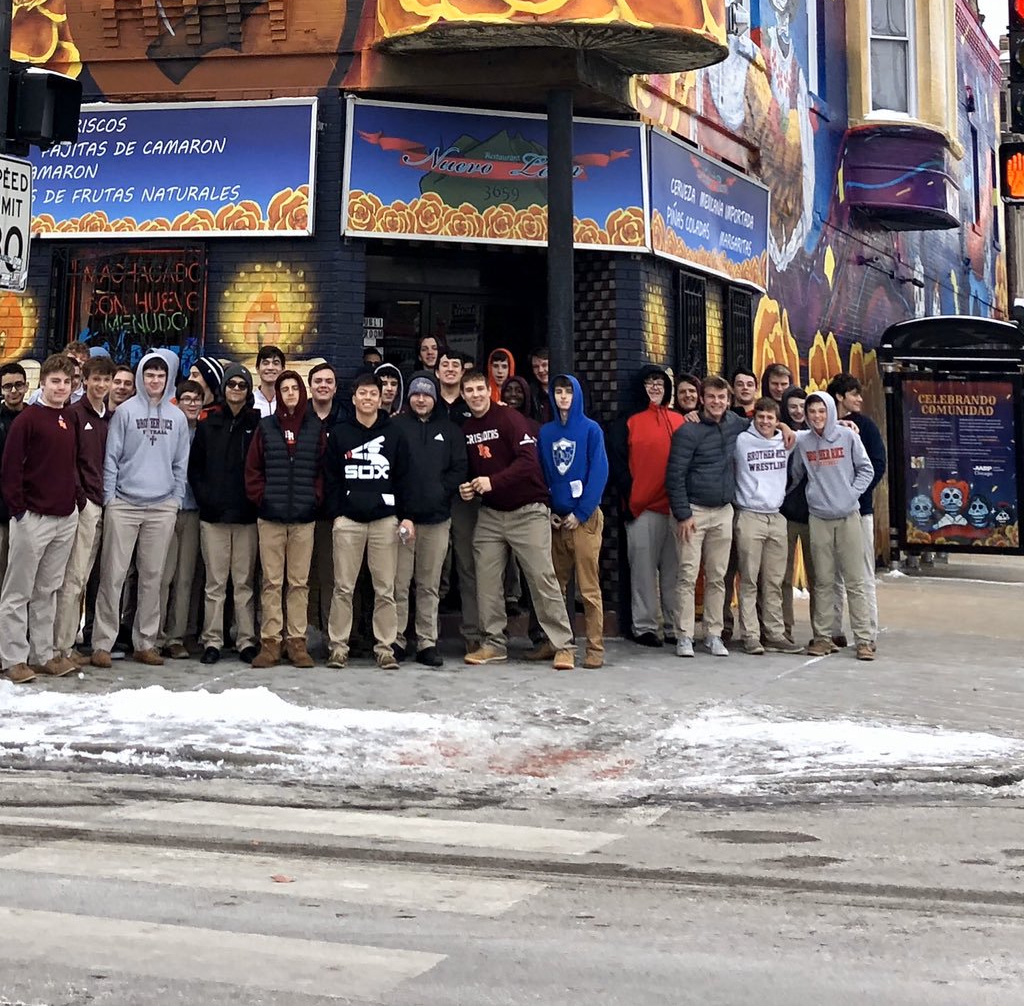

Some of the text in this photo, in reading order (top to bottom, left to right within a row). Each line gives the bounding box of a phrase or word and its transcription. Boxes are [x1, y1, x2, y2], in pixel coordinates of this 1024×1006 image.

[113, 139, 136, 156] DE
[142, 137, 227, 155] CAMARON
[402, 146, 585, 179] Nuevo Len
[32, 163, 98, 180] AMARON
[43, 189, 66, 204] DE
[72, 187, 134, 203] FRUTAS
[141, 184, 241, 202] NATURALES
[483, 185, 520, 202] 3659
[670, 177, 696, 205] CERVEZA
[699, 191, 724, 217] MEXICANA
[724, 204, 755, 230] IMPORTADA
[104, 312, 188, 333] MENUDO
[918, 394, 996, 405] CELEBRANDO
[921, 405, 994, 416] COMUNIDAD
[344, 464, 390, 480] SOX
[748, 460, 786, 472] WRESTLING
